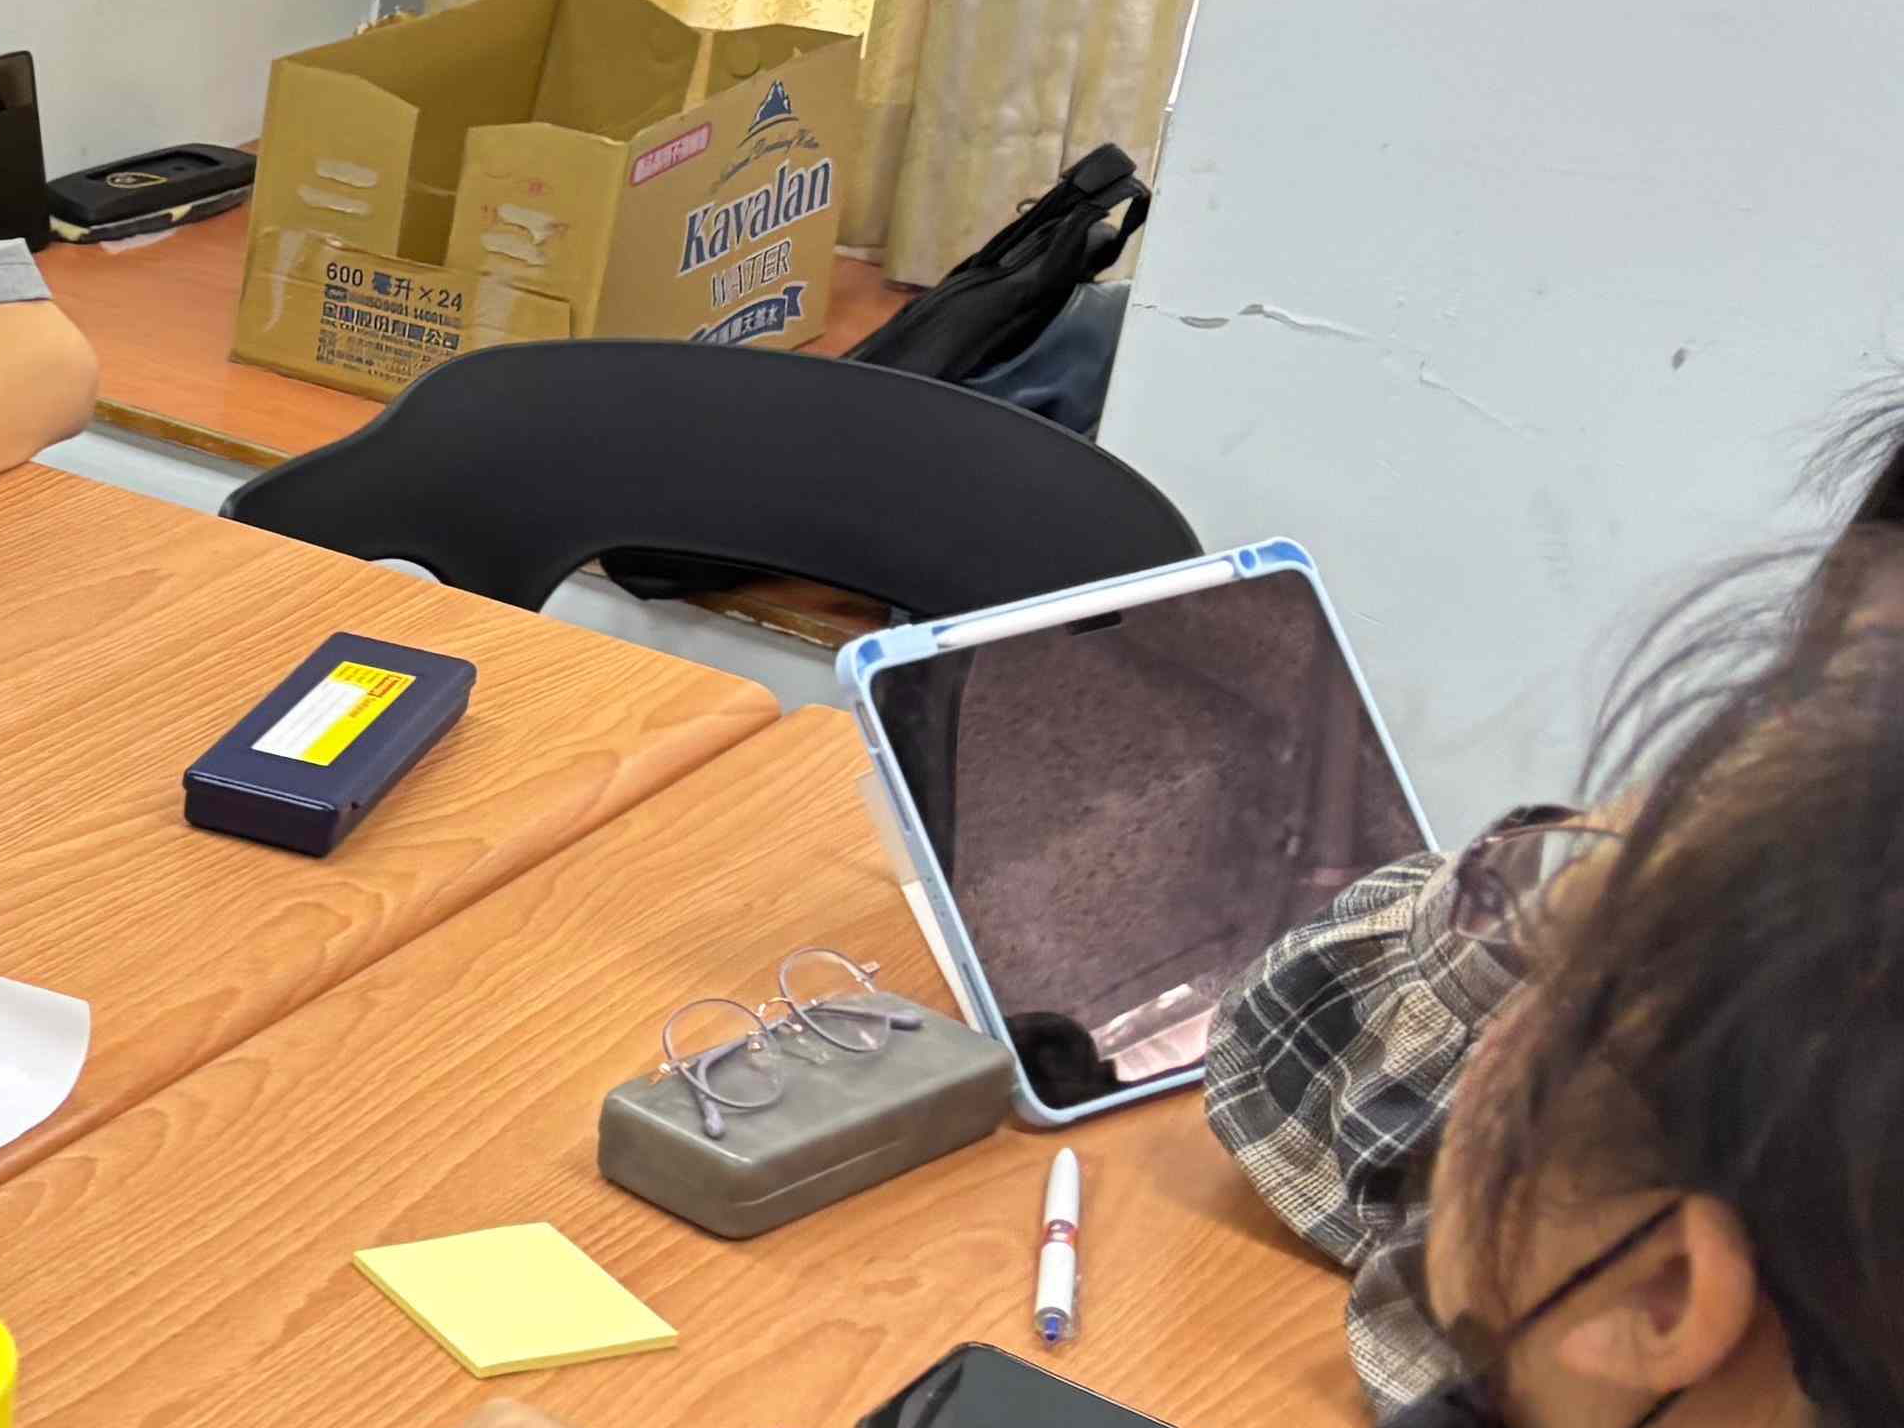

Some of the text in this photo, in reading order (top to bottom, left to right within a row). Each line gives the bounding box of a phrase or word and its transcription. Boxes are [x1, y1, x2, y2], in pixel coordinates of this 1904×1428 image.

[679, 157, 832, 275] Kavalan
[326, 262, 364, 287] 600
[438, 290, 463, 312] 24
[711, 239, 791, 307] WATER
